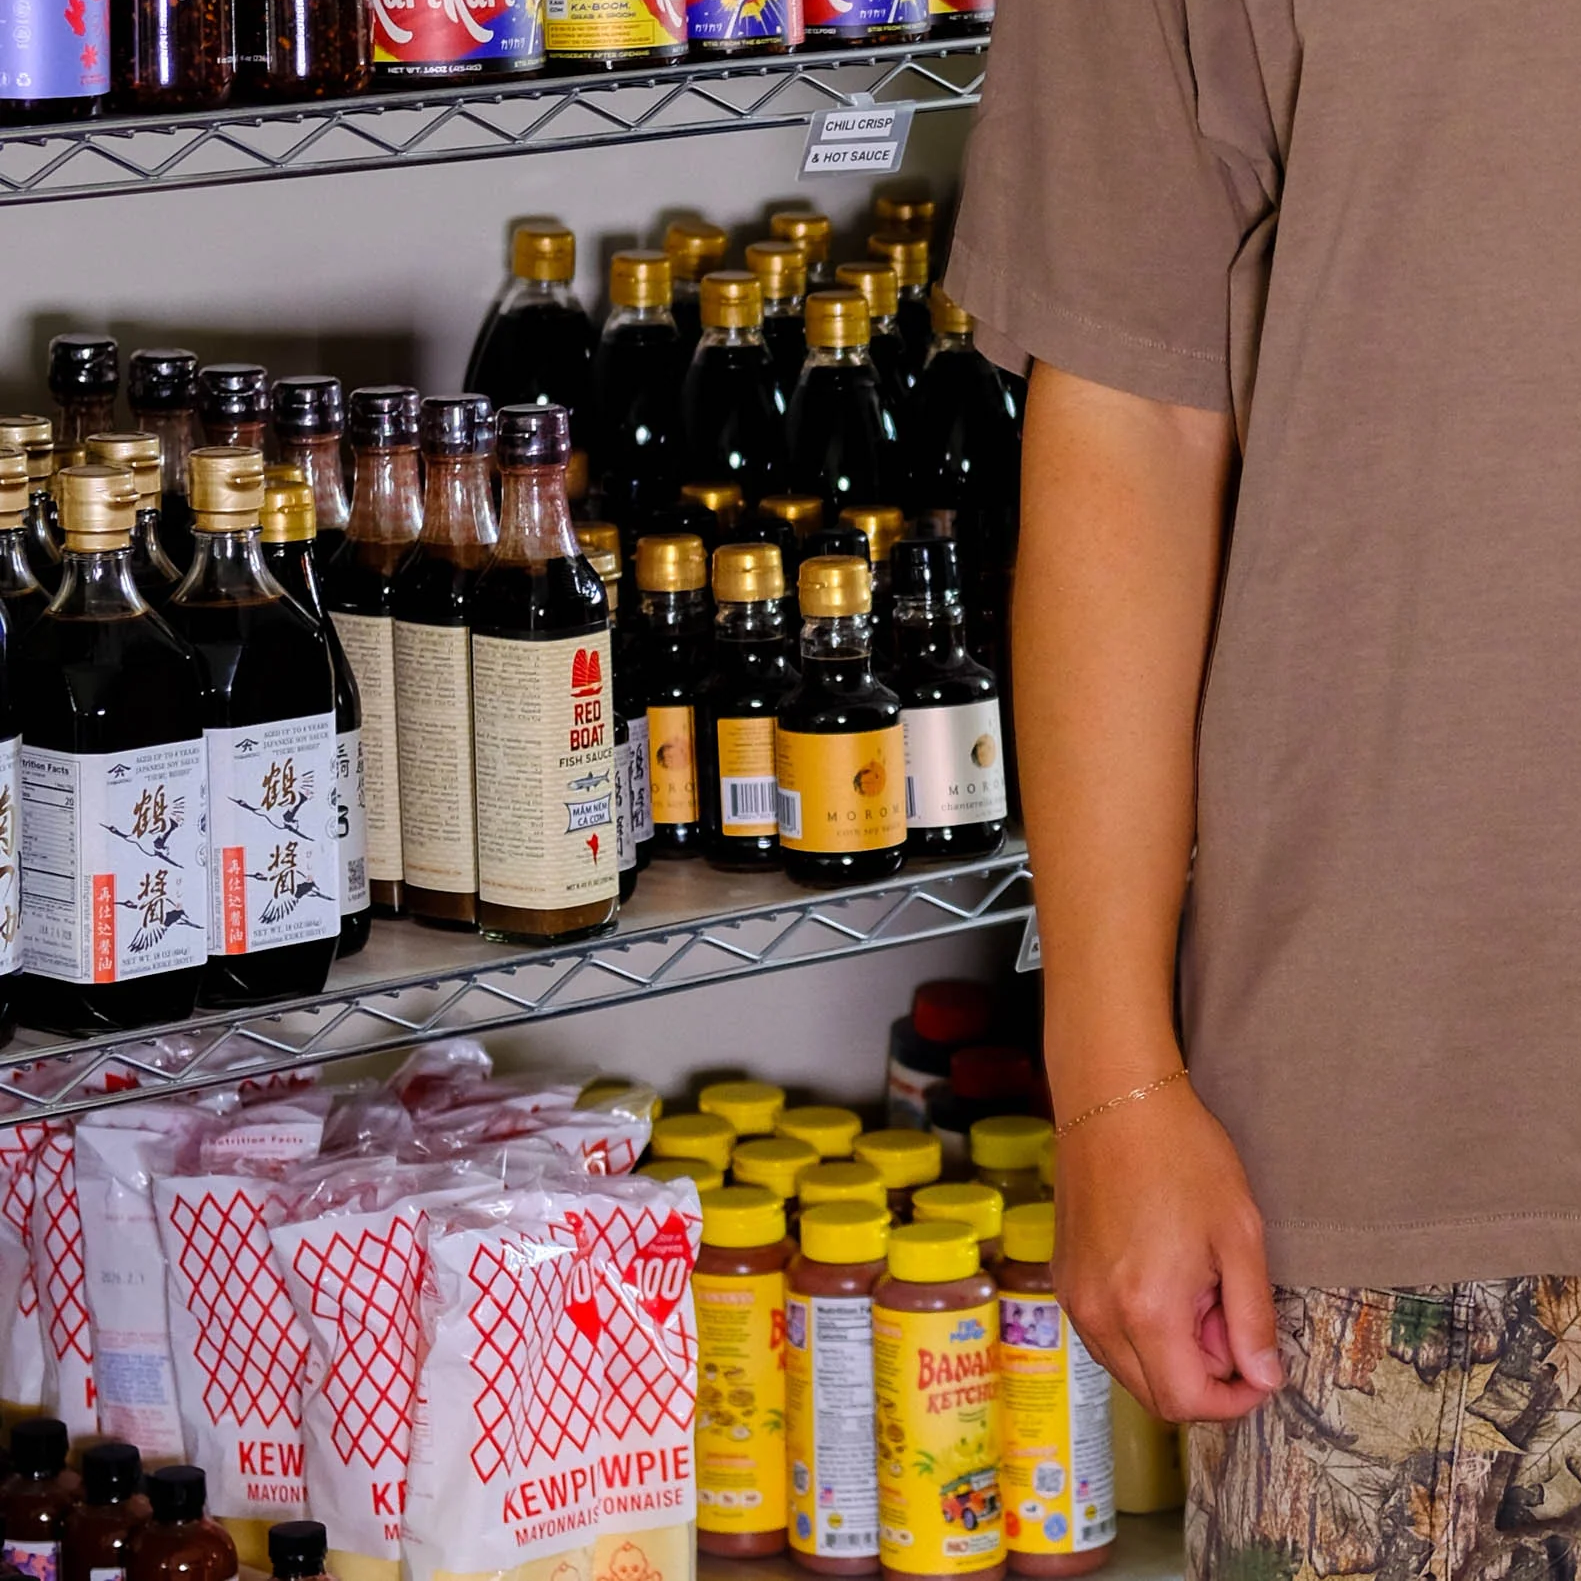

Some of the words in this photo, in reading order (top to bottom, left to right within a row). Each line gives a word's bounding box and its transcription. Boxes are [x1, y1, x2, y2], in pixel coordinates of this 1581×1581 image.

[571, 2, 631, 11] KA-BOOM.
[825, 120, 856, 131] CHILI
[858, 118, 893, 130] CRISP
[811, 153, 819, 163] &
[823, 151, 848, 163] HOT
[850, 150, 891, 161] SAUCE
[574, 699, 602, 726] RED
[263, 737, 295, 750] JAPANESE
[570, 723, 605, 751] BOAT
[559, 755, 583, 768] FISH
[585, 747, 613, 764] SAUCE
[47, 762, 70, 776] Facts
[65, 797, 74, 807] 20
[271, 1135, 304, 1146] Facts
[238, 1441, 306, 1477] KEW
[600, 1446, 691, 1490] WPIE
